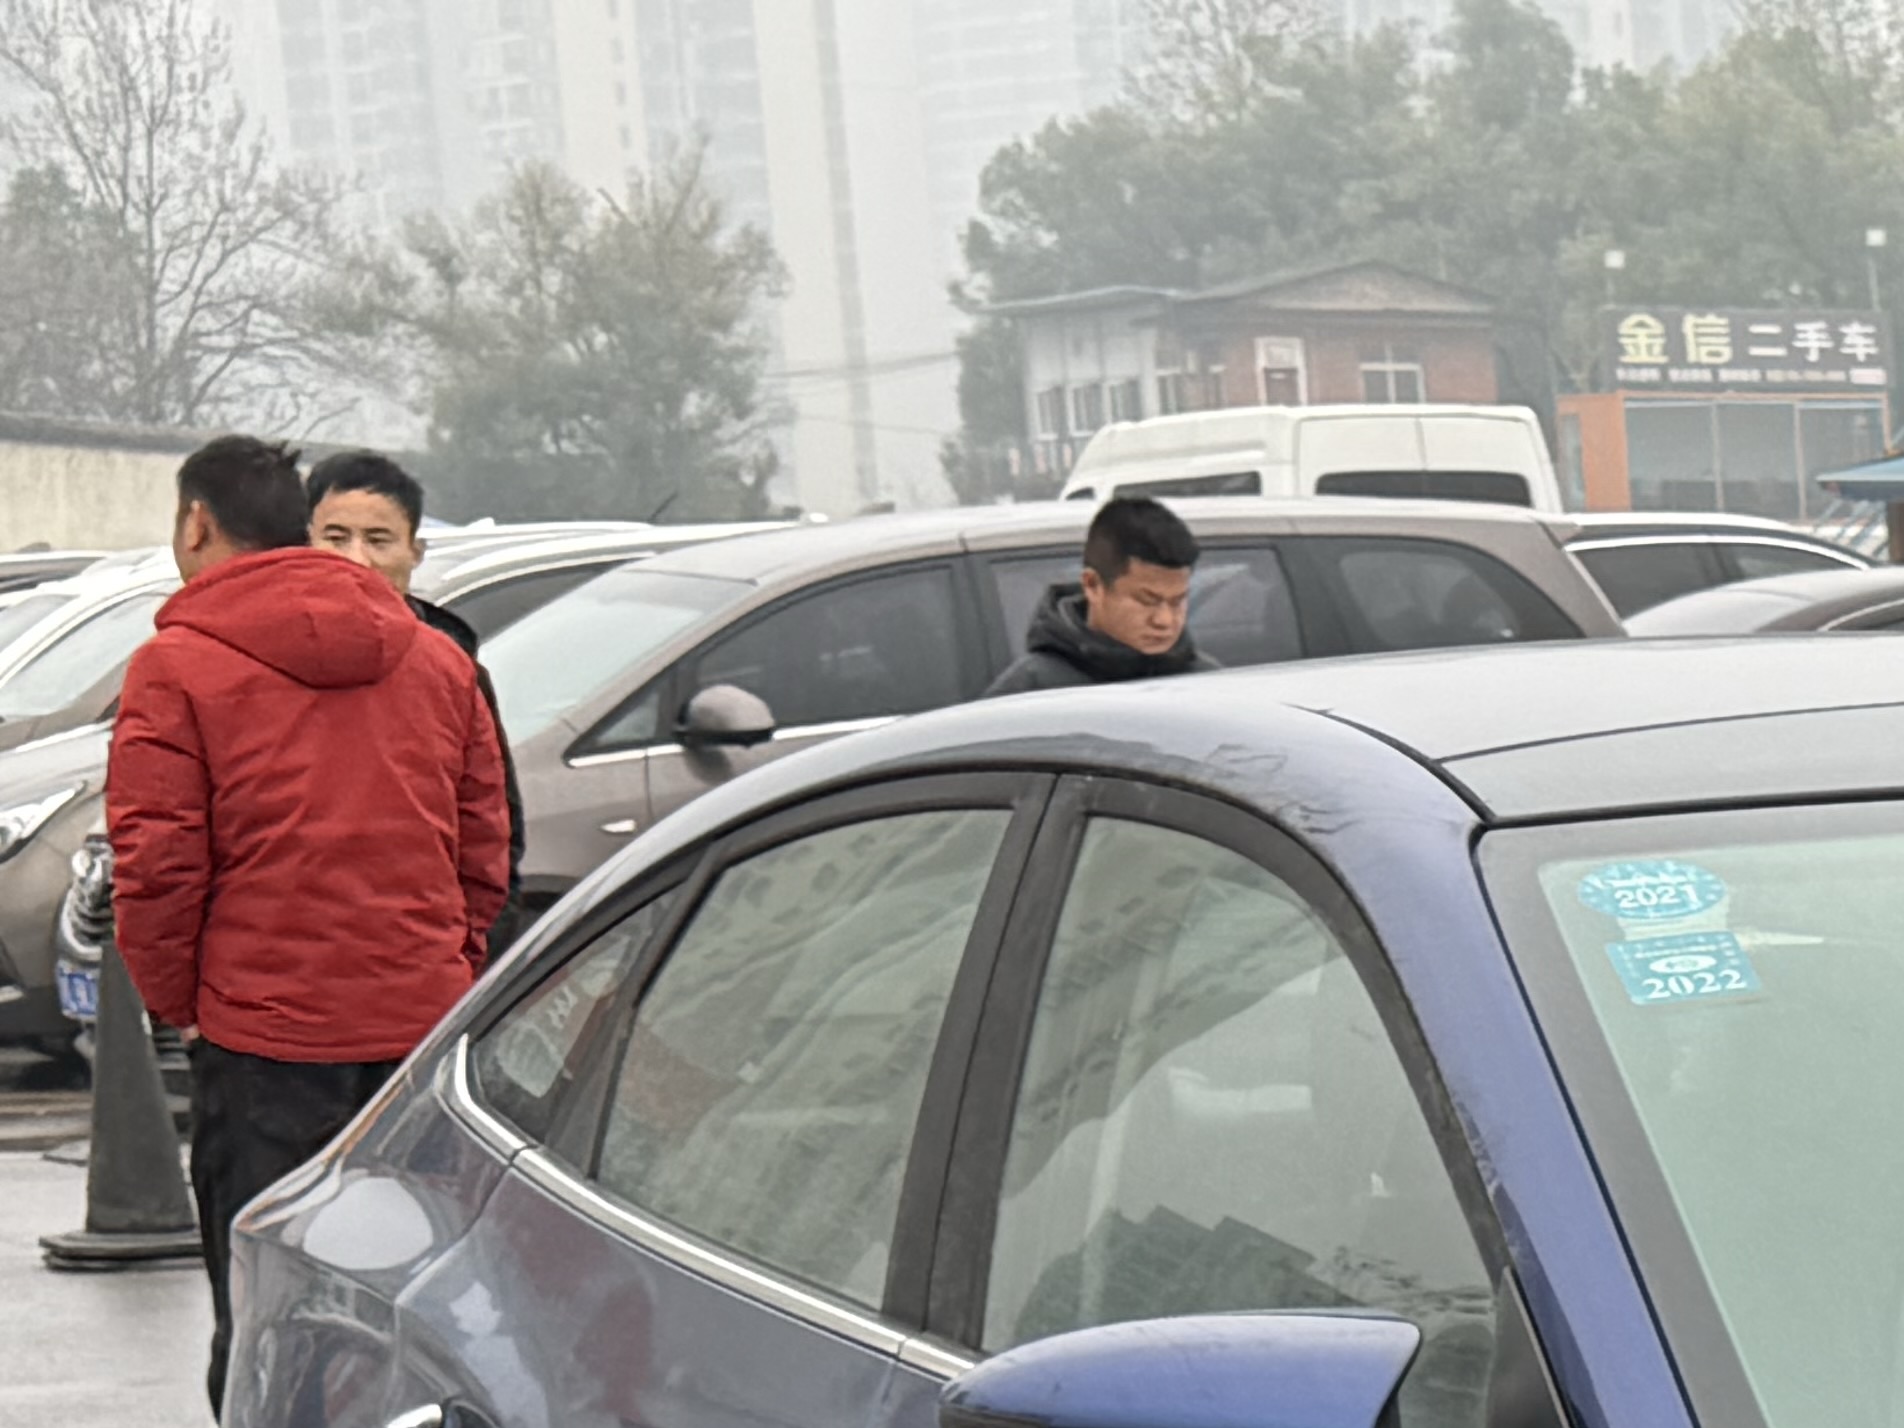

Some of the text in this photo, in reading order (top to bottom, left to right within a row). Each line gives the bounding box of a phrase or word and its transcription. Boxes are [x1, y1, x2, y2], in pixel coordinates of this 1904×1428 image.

[1617, 313, 1880, 364] 金信二手车
[1614, 884, 1700, 909] 2021
[1641, 969, 1747, 999] 2022
